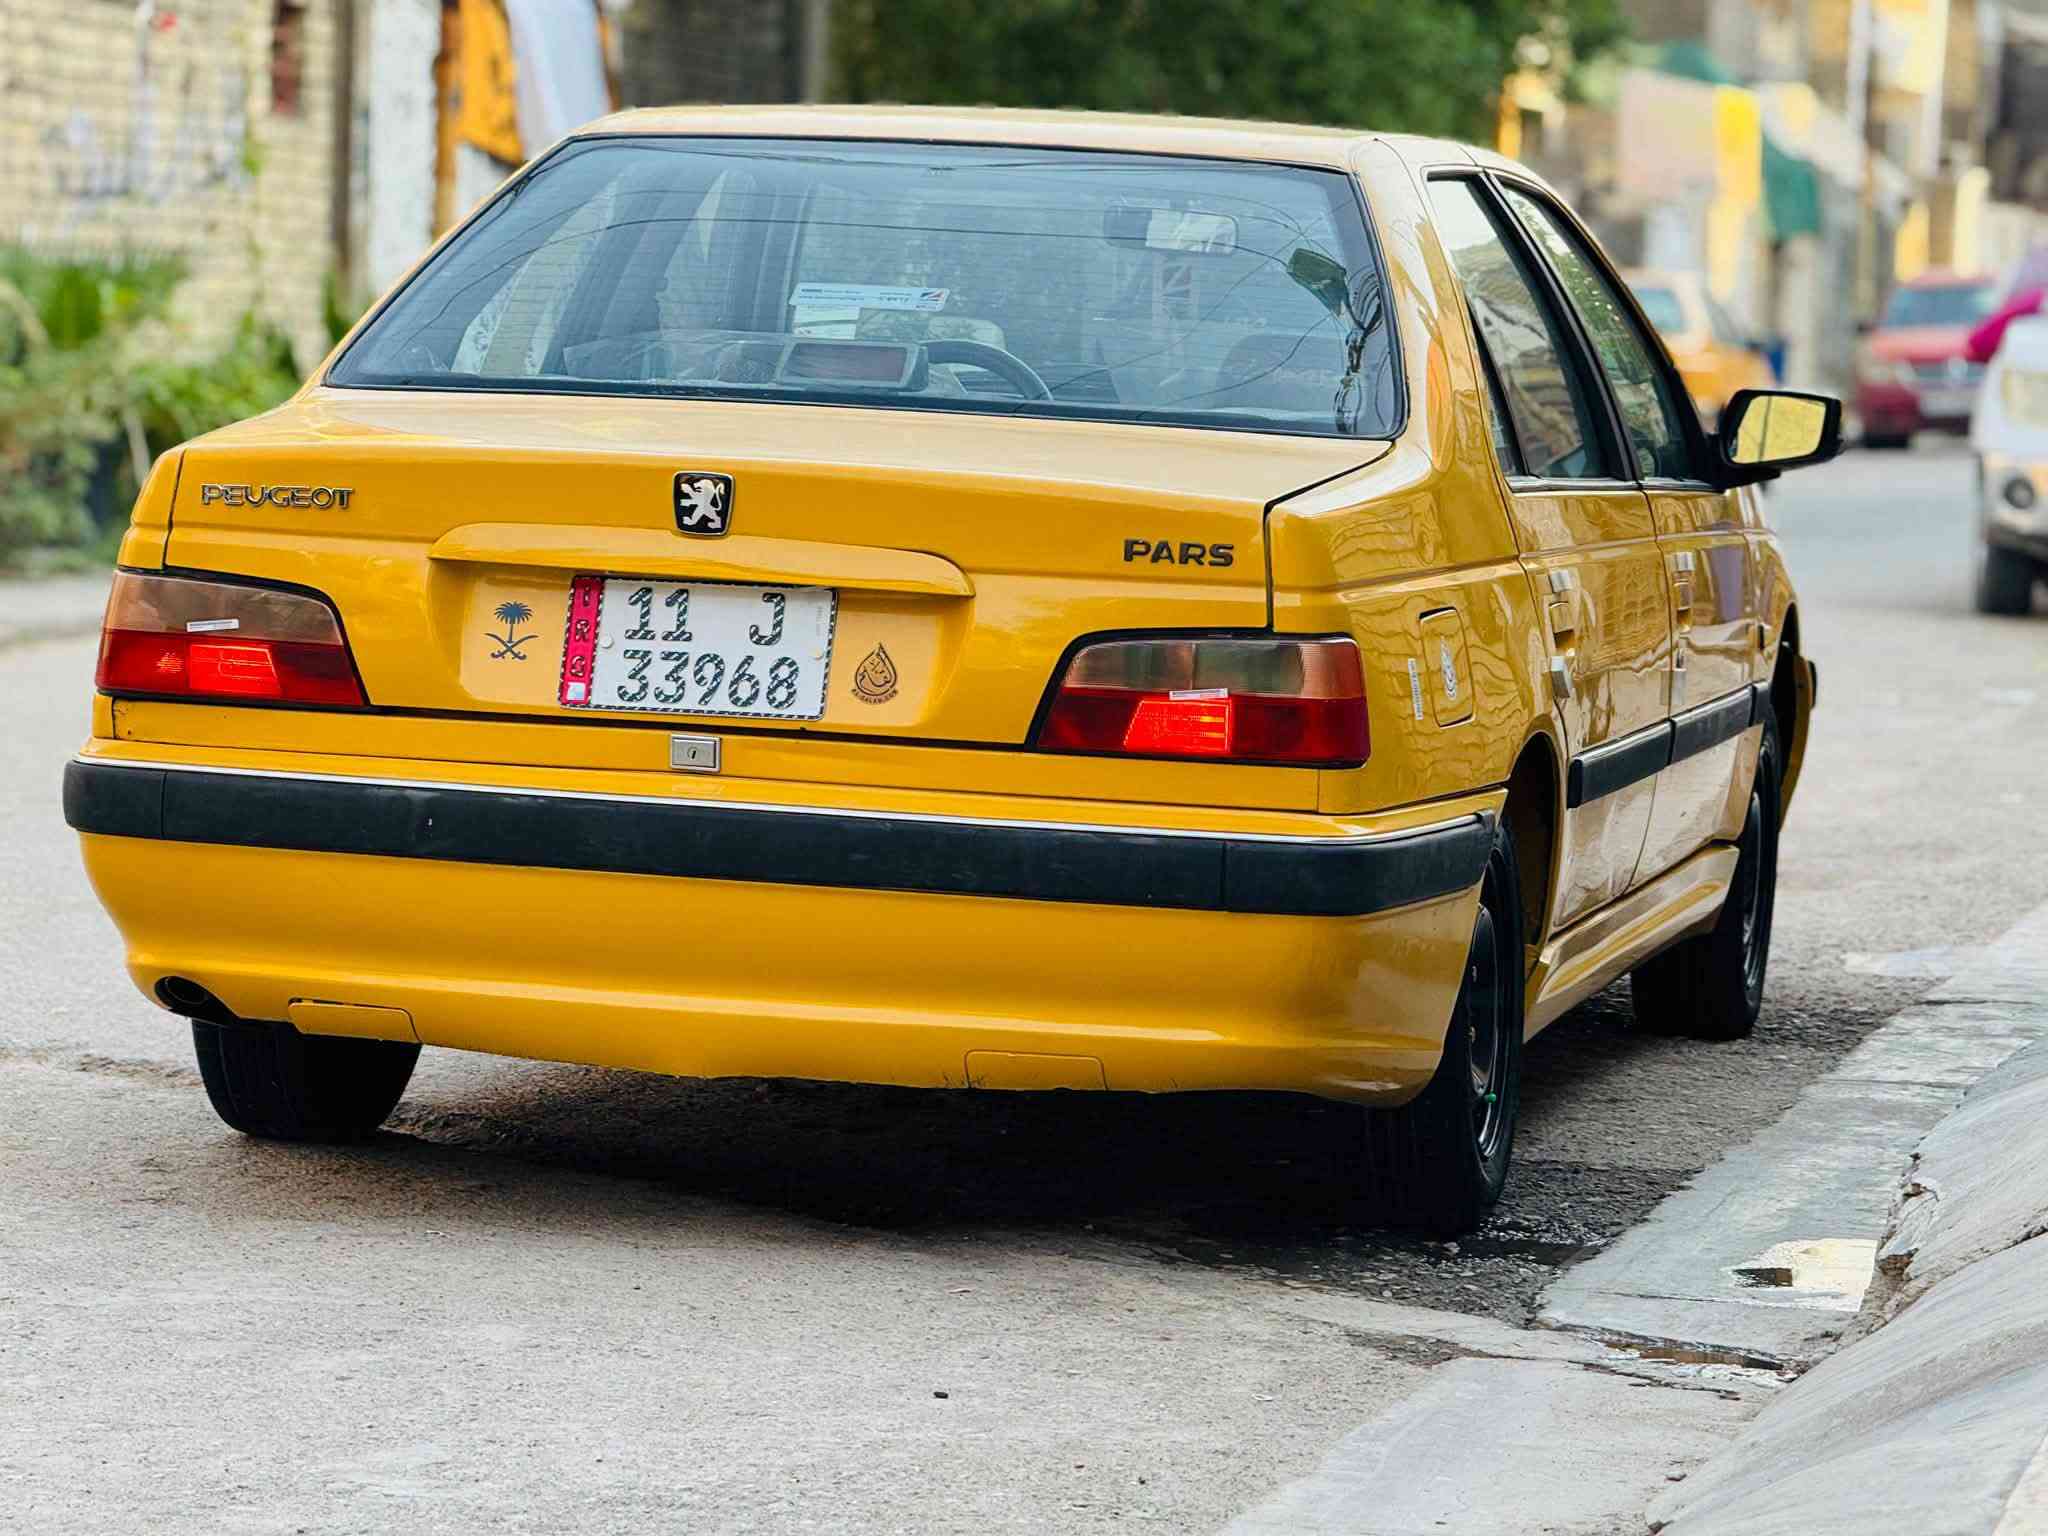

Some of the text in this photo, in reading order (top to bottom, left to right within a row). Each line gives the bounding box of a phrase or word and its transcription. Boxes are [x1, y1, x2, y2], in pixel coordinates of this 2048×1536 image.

[201, 484, 354, 510] PEUGEOT
[1123, 539, 1234, 567] PARS
[624, 586, 693, 642] 11
[749, 592, 786, 646] J
[617, 649, 800, 710] 33968
